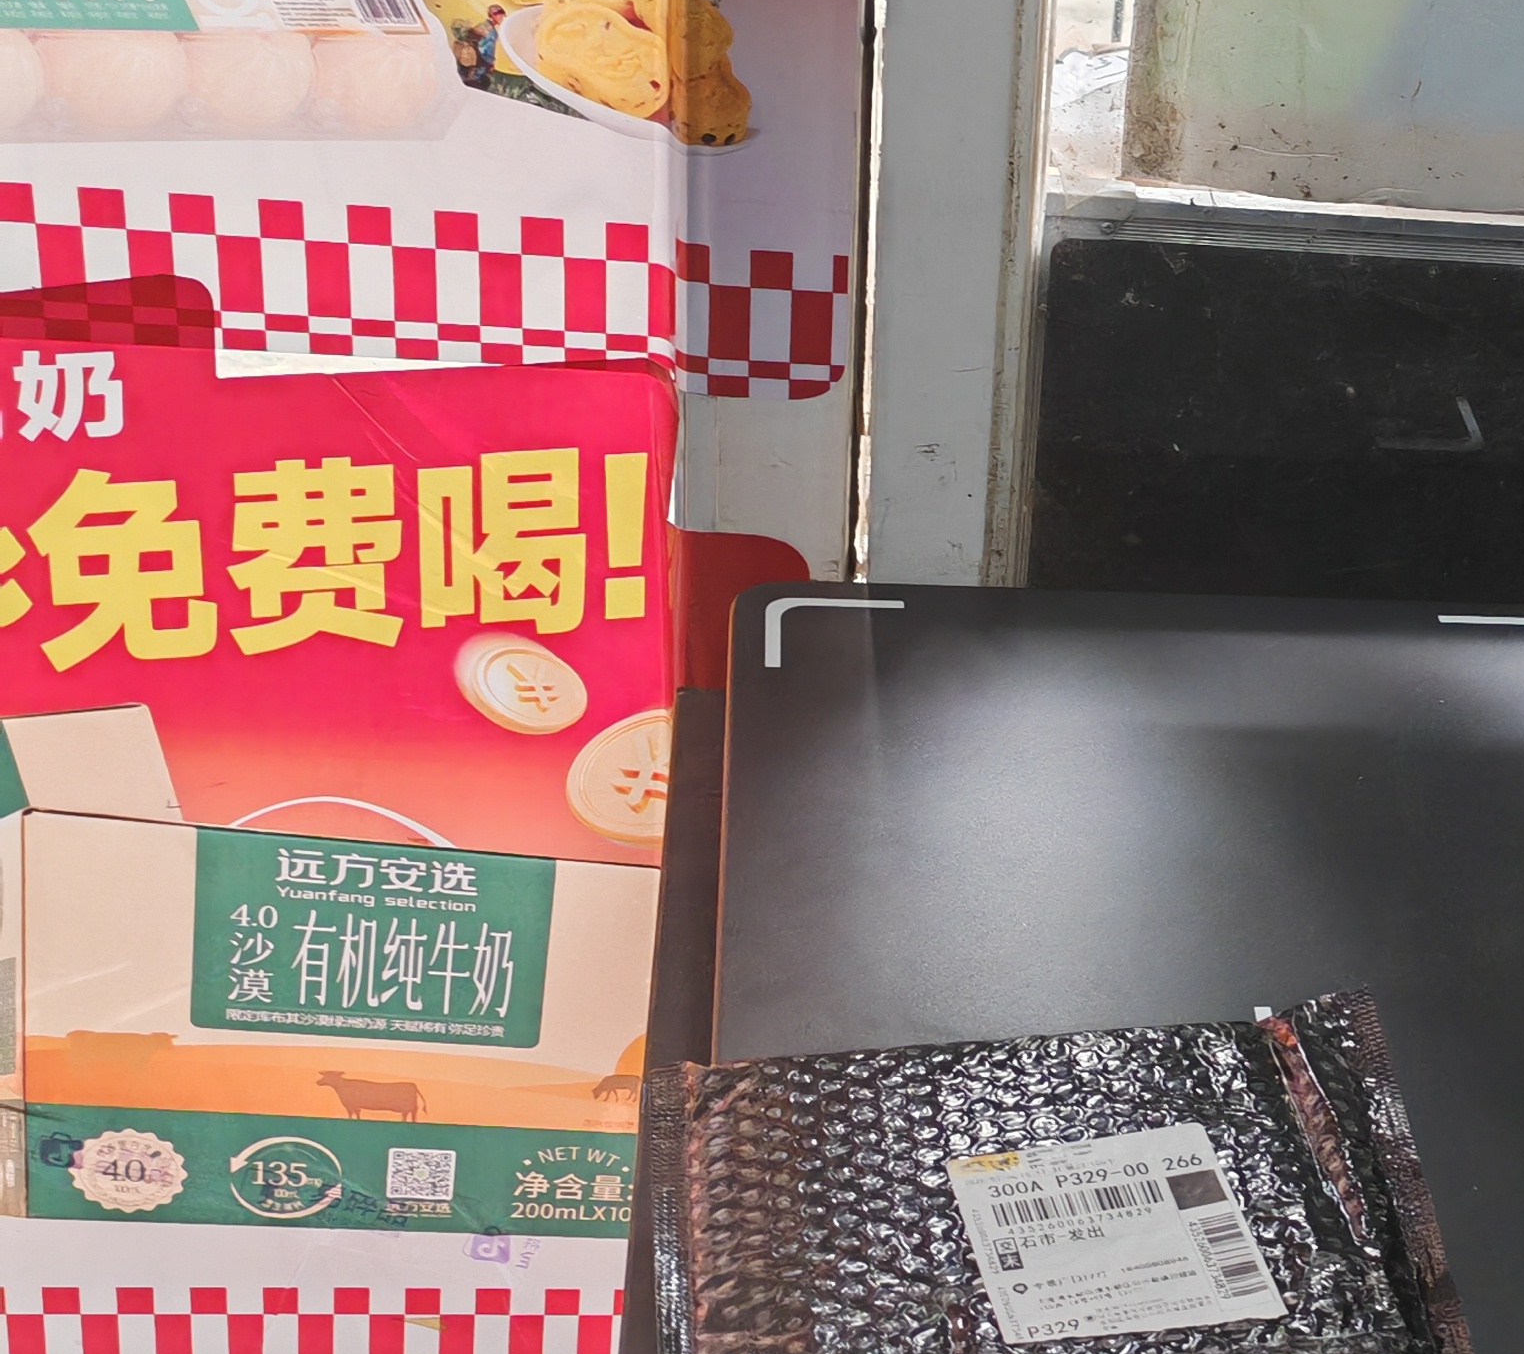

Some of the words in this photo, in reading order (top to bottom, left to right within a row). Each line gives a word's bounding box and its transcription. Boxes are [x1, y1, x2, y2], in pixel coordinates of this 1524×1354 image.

[0, 446, 648, 673] 免费喝!
[275, 849, 479, 897] 远方安选
[276, 886, 376, 908] Yuanfang
[384, 894, 477, 913] selection
[229, 904, 278, 929] 4.0
[291, 910, 515, 1019] 有机纯牛奶
[538, 1146, 581, 1163] NET
[587, 1148, 620, 1167] WT
[251, 1161, 308, 1186] 135
[988, 1180, 1044, 1199] 300A
[1055, 1162, 1149, 1189] P329-00
[1162, 1153, 1203, 1172] 266
[1027, 1318, 1080, 1340] P329
